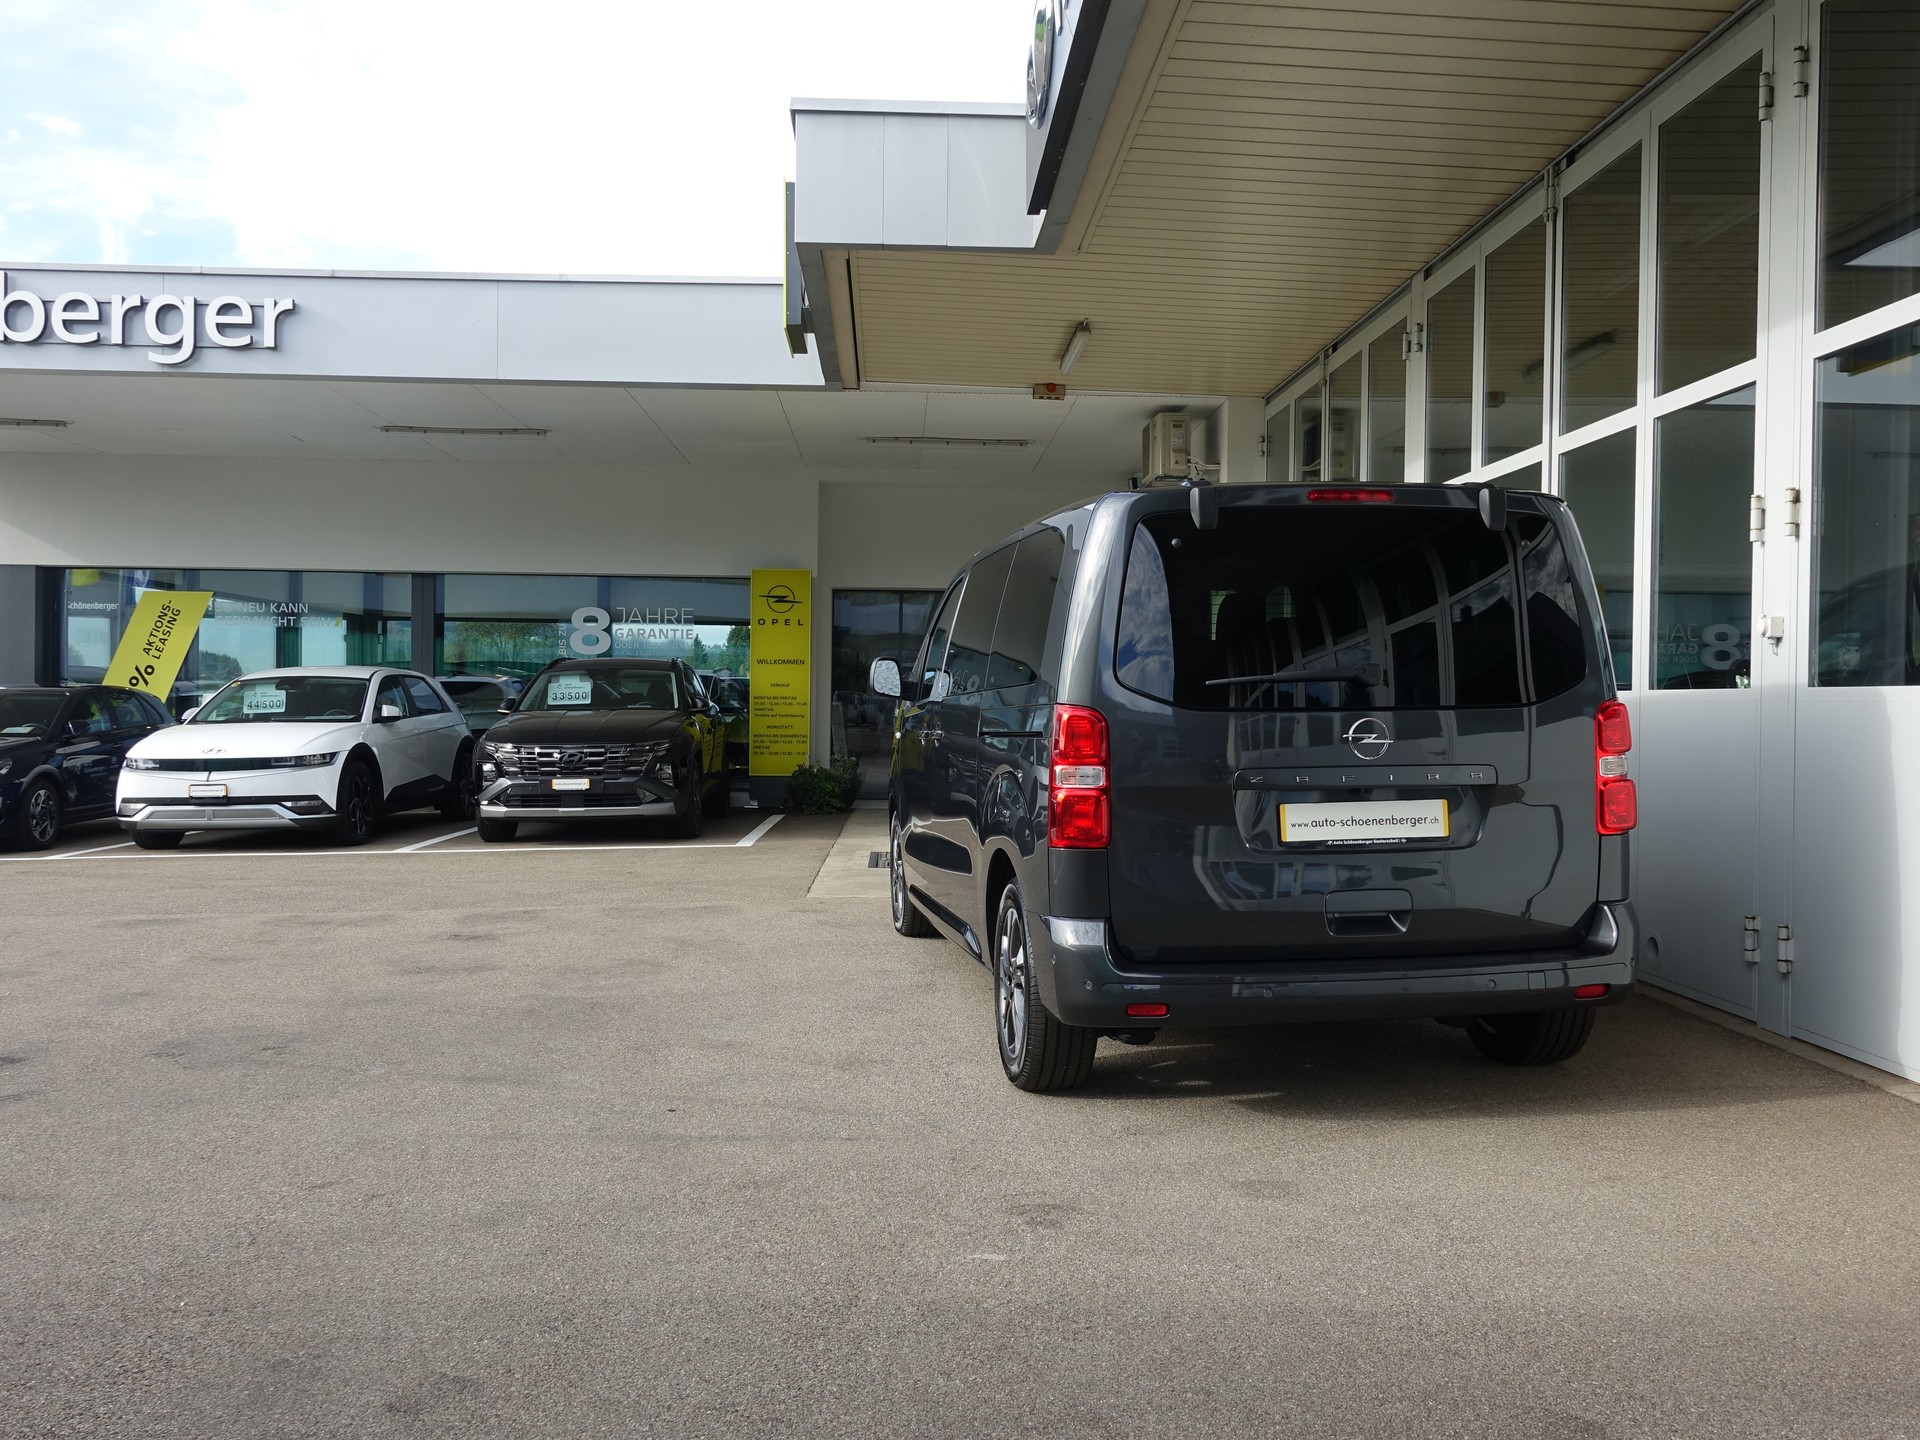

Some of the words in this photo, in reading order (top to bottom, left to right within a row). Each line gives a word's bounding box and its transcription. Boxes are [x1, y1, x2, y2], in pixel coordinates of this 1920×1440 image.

[0, 271, 295, 365] berger
[238, 602, 266, 613] NEU
[270, 602, 309, 613] KANN
[615, 607, 694, 625] JAHRE
[143, 600, 172, 656] AKTIONS-
[215, 615, 297, 627] GEBRAUCHT
[757, 618, 805, 626] OPEL
[151, 608, 181, 660] LEASING
[569, 606, 612, 655] 8
[615, 628, 694, 640] GARANTIE
[558, 638, 567, 655] BIS
[129, 664, 155, 687] %
[1250, 772, 1483, 783] ZAFIRA
[1290, 814, 1440, 828] www.auto-schoenenberger.ch
